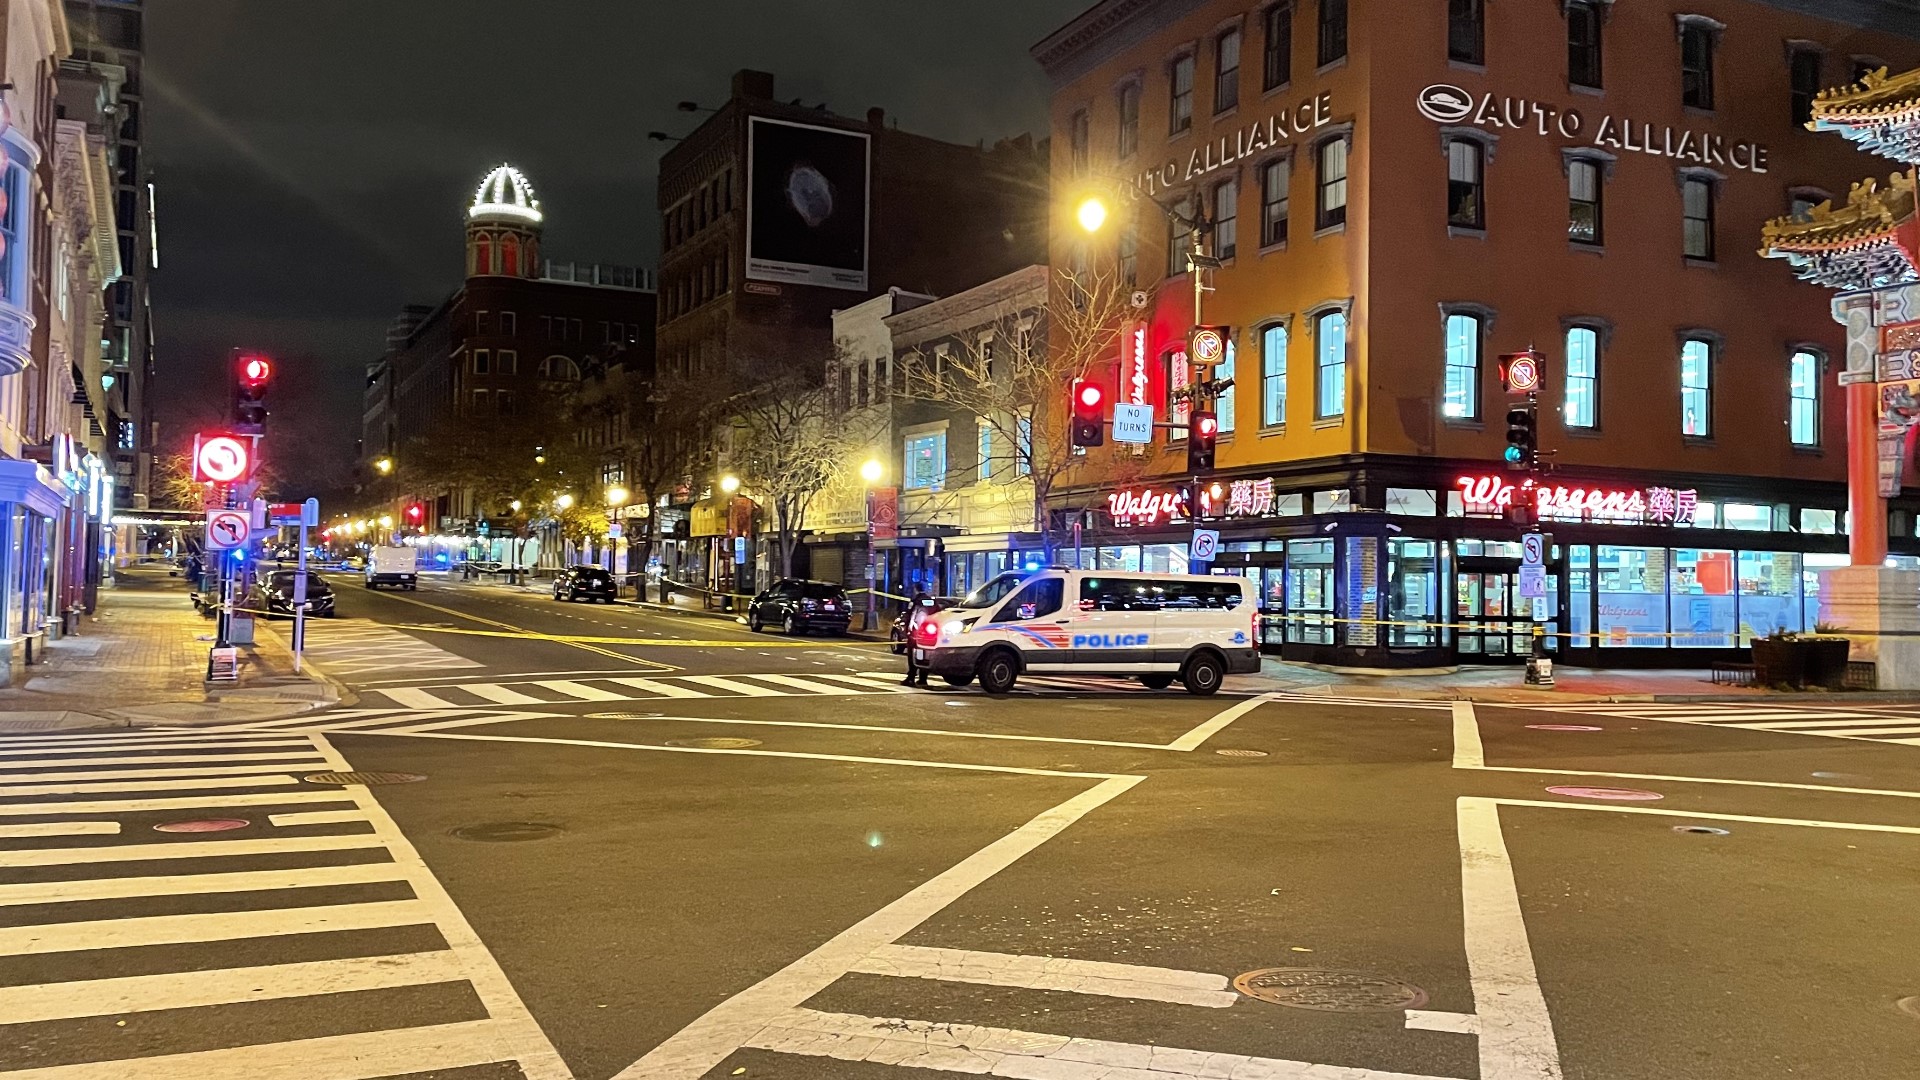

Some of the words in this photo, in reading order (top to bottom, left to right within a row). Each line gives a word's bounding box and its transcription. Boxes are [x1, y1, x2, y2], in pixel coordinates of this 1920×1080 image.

[1115, 161, 1177, 207] AUTO
[1185, 91, 1332, 182] ALLIANCE
[1474, 92, 1583, 139] AUTO
[1594, 114, 1768, 174] ALLIANCE
[1119, 422, 1147, 433] TURNS
[1127, 408, 1140, 418] NO
[1229, 478, 1274, 516] 藥房
[1458, 476, 1647, 515] Wagreens
[1648, 487, 1697, 522] 藥房
[1073, 633, 1149, 648] POLICE
